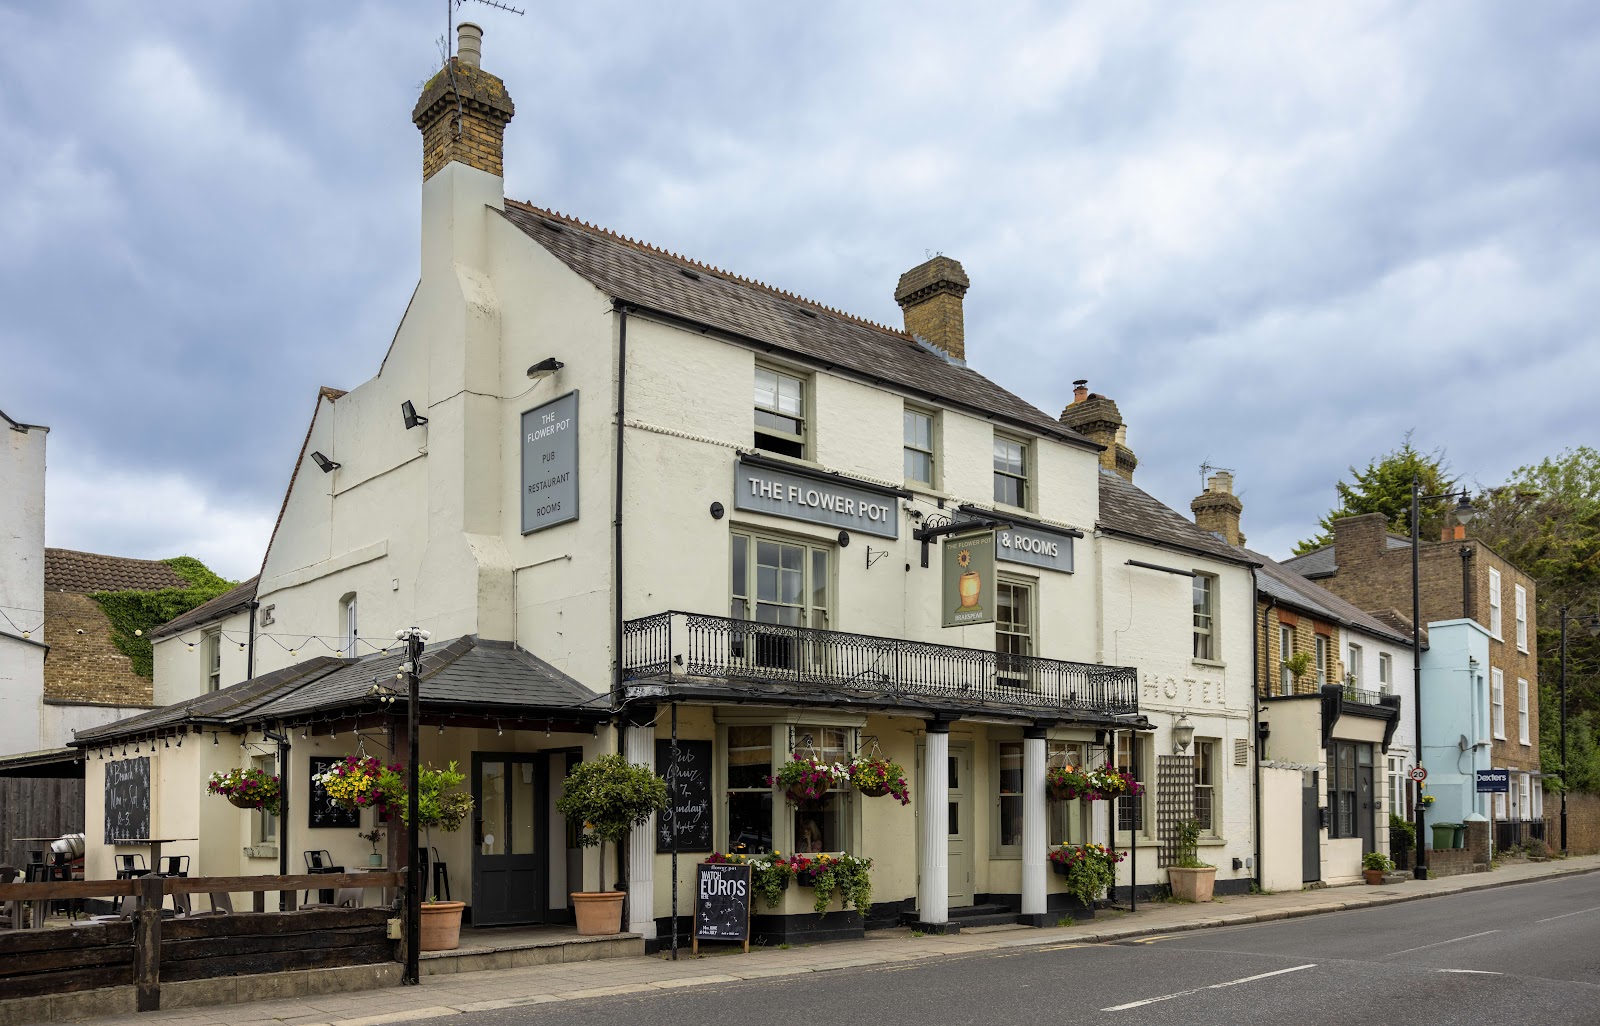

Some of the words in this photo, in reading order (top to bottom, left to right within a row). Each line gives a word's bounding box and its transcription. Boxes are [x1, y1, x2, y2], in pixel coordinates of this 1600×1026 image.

[542, 412, 555, 424] THE
[527, 424, 555, 443] FLOWER
[556, 419, 570, 433] POT
[542, 451, 556, 463] PUB
[528, 472, 571, 494] RESTAURANT
[749, 478, 783, 500] THE
[788, 485, 854, 516] FLOWER
[859, 501, 889, 522] POT
[536, 502, 561, 517] ROOMS
[958, 539, 980, 548] FLOWER
[980, 537, 992, 545] POT
[1002, 532, 1012, 548] &
[1014, 534, 1059, 557] ROOMS
[1143, 673, 1225, 704] HOTEL
[701, 871, 721, 880] WATCH
[700, 880, 746, 896] EUROS
